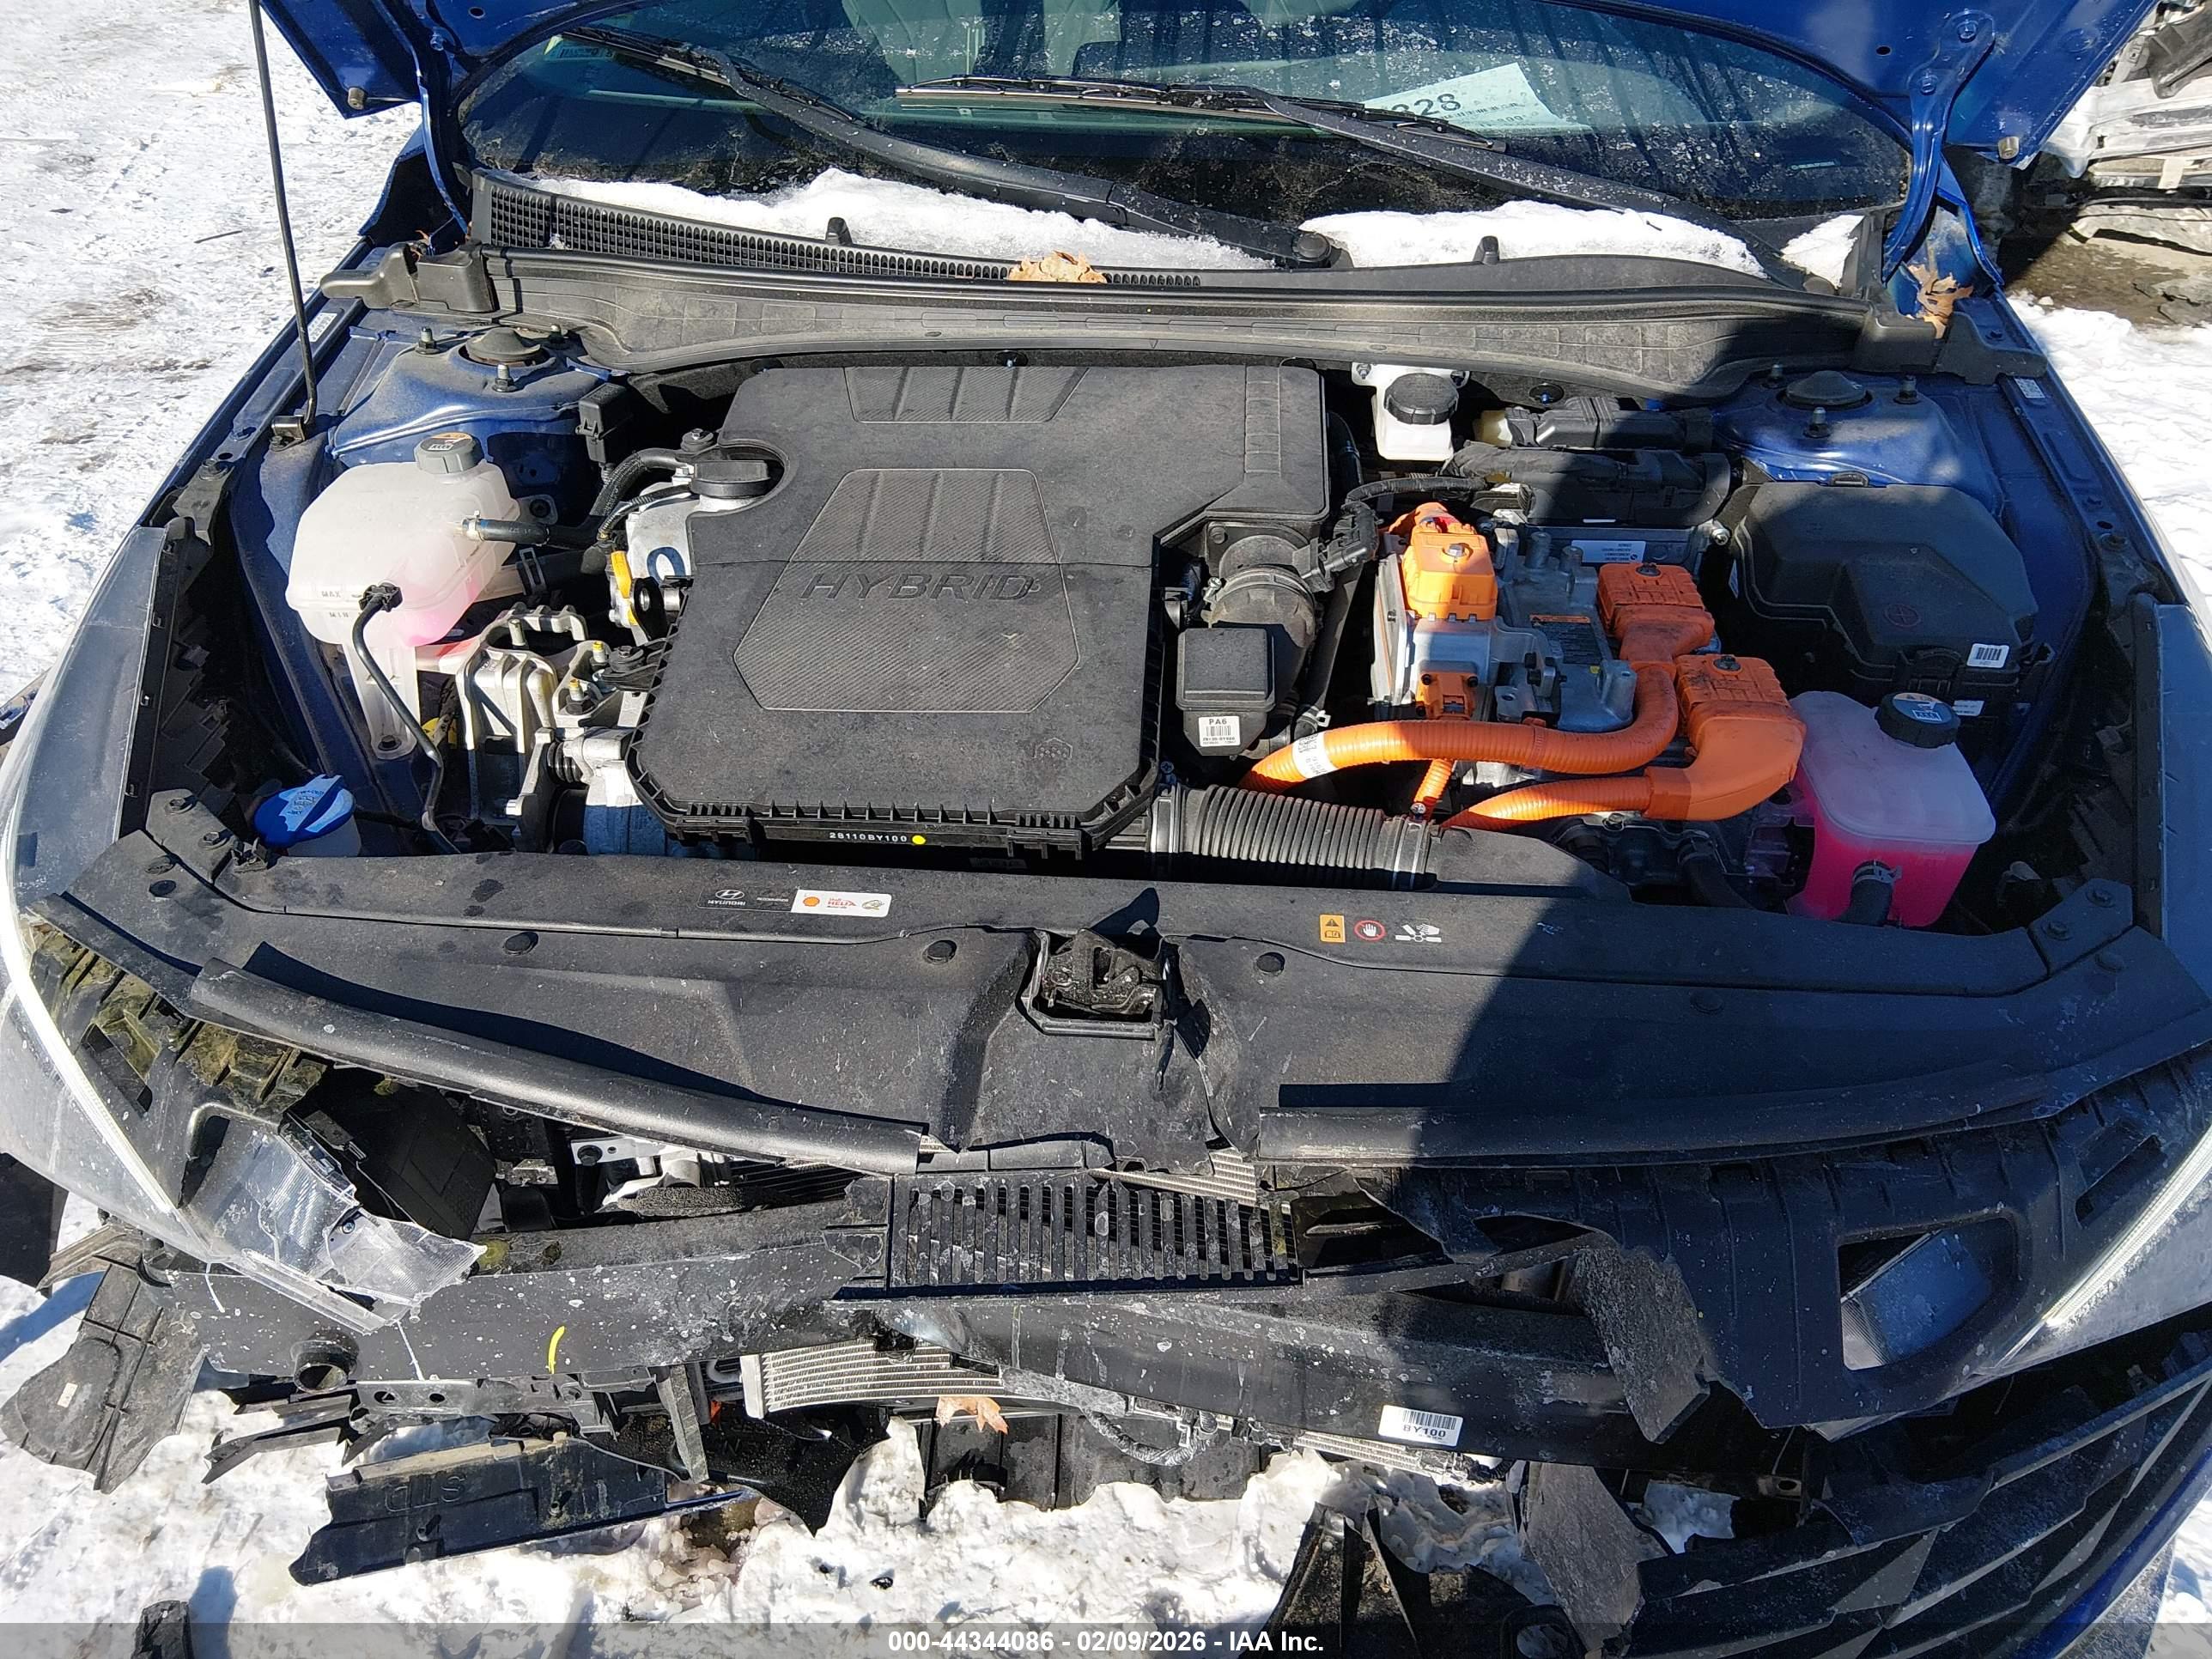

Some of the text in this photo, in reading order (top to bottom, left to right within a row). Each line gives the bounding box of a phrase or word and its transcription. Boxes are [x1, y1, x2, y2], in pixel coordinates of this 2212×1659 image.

[798, 573, 1036, 600] HYBRID
[829, 831, 908, 842] 28110BY100
[1402, 1425, 1446, 1437] BY100
